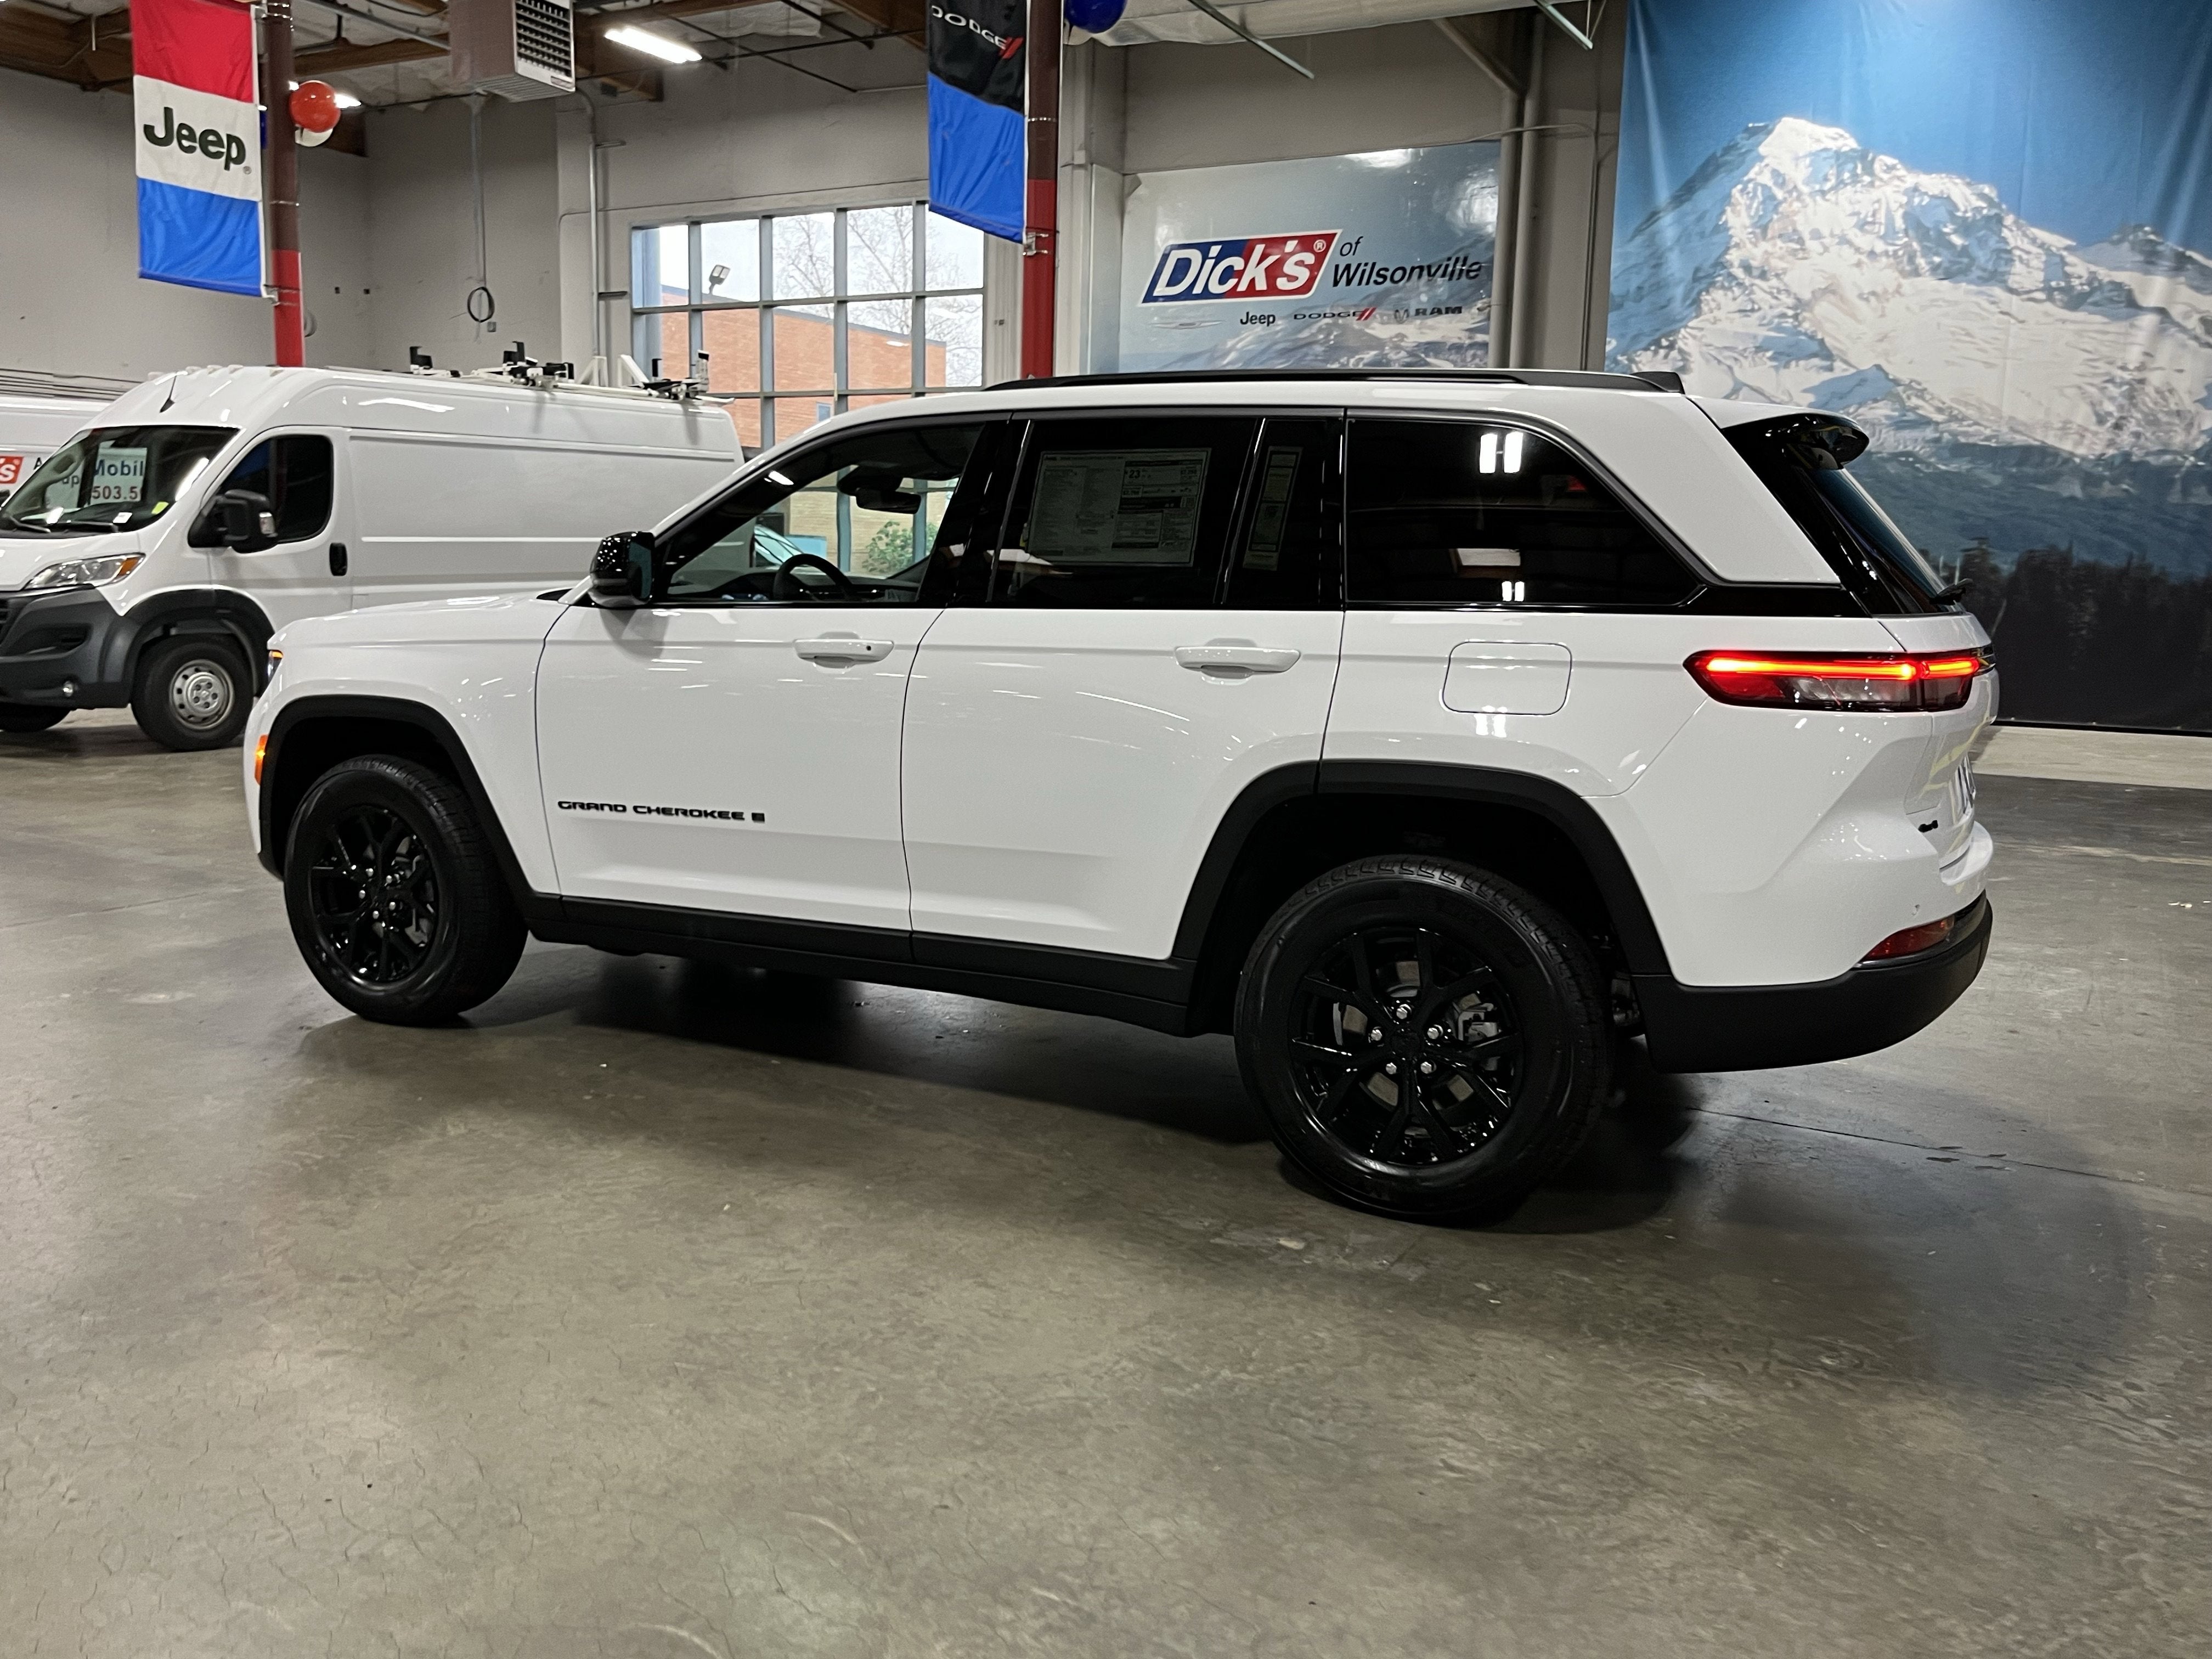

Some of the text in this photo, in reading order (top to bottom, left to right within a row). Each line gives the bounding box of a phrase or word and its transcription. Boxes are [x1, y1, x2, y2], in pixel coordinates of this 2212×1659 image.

[932, 5, 1007, 50] DODGE
[144, 106, 246, 171] Jeep
[1153, 236, 1363, 296] Dick's of
[1333, 256, 1482, 287] Wilsonville
[1240, 306, 1463, 326] Jeep DODGE RAM
[94, 459, 144, 476] Mobil
[92, 486, 141, 500] 503.5
[557, 801, 744, 821] GRAND CHEROKEE
